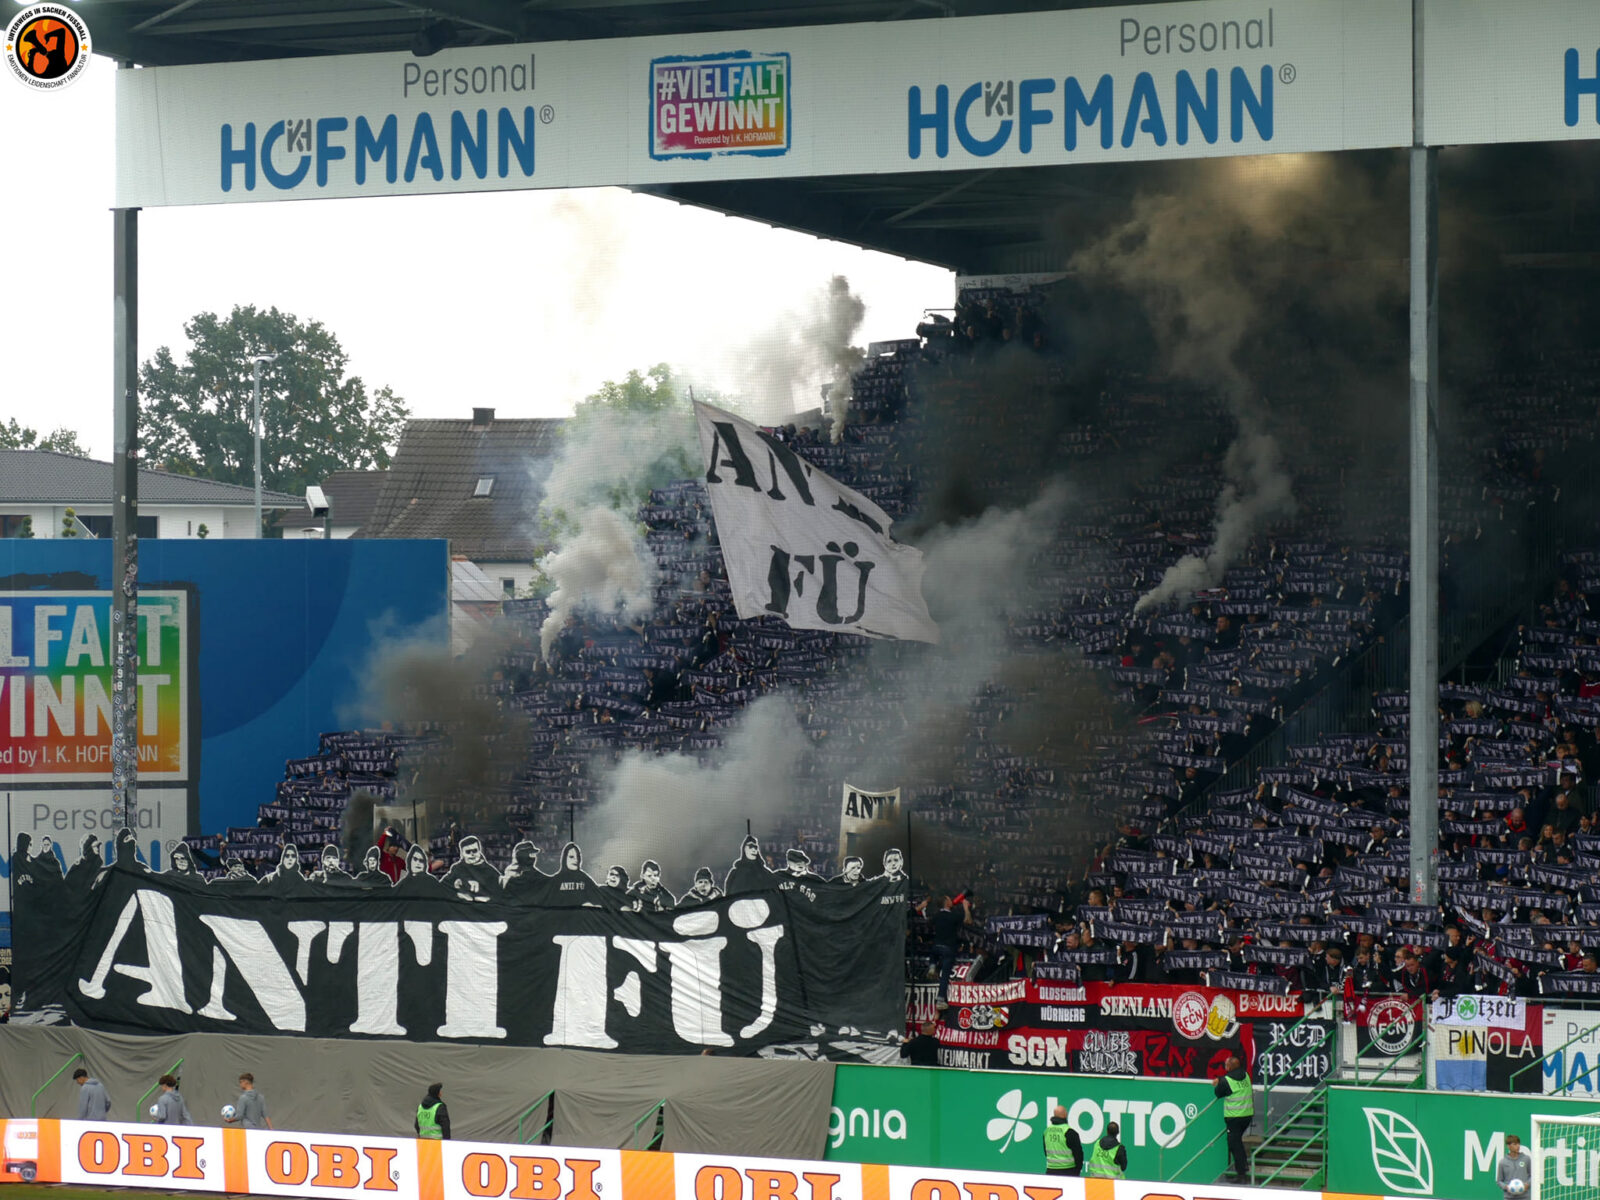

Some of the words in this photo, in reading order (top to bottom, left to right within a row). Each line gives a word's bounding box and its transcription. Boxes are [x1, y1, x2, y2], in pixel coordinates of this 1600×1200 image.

[1121, 8, 1273, 57] Personal
[404, 53, 536, 98] Personal
[659, 64, 780, 101] #VIELFALT
[660, 98, 780, 134] GEWINNT
[694, 135, 721, 144] Powered
[722, 135, 730, 144] by
[744, 132, 776, 141] HOFMANN
[765, 541, 876, 624] FÜ
[18, 745, 37, 768] by
[56, 745, 67, 763] K.
[78, 888, 508, 1038] ANTI
[543, 898, 784, 1049] FÜ
[960, 979, 1026, 1004] BESESSENEN
[1041, 1006, 1085, 1022] NÜRNBERG
[1183, 1009, 1204, 1028] FCN
[935, 1026, 999, 1047] STAMMTISCH
[1269, 1022, 1327, 1048] RED
[1449, 1029, 1536, 1059] PINOLA
[937, 1048, 991, 1070] NEUMARKT
[1008, 1034, 1068, 1067] SGN
